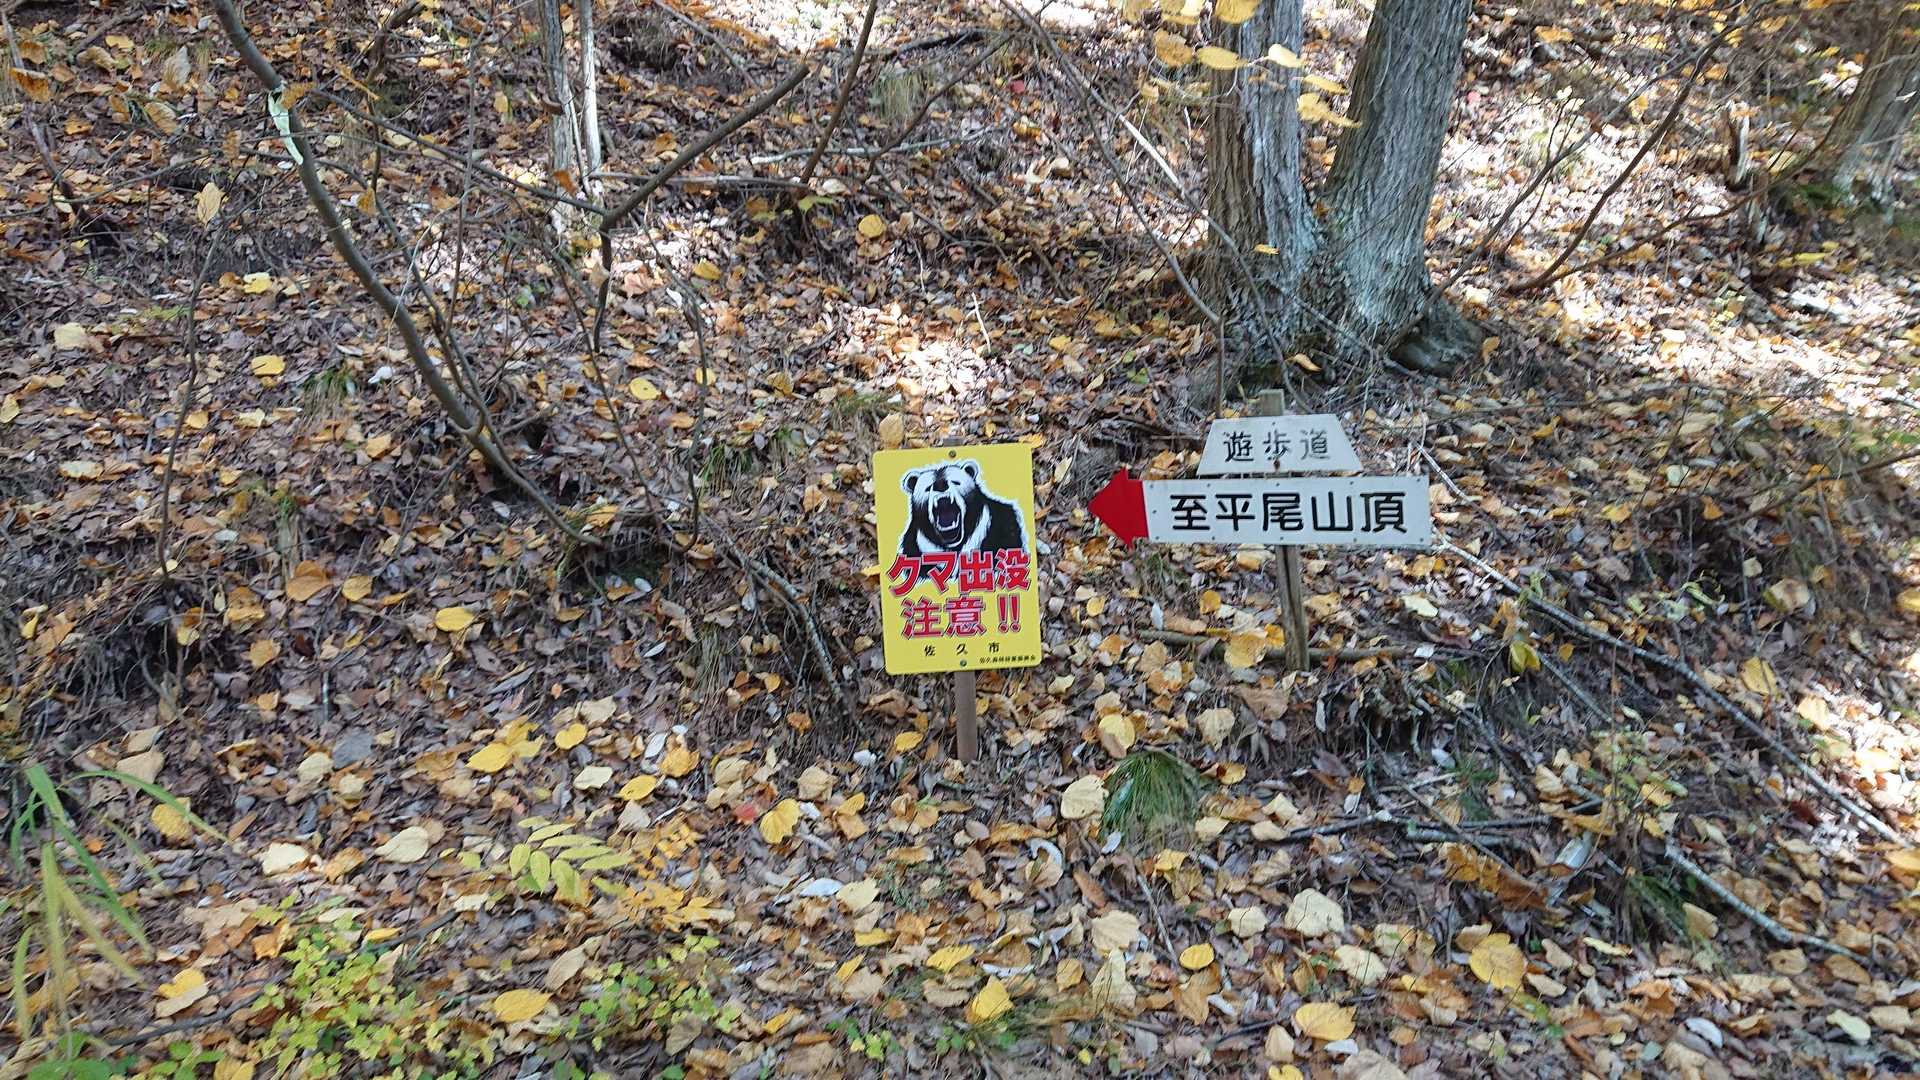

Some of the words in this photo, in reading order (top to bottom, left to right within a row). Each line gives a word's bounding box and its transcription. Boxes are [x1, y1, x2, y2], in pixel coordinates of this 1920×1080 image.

[1222, 429, 1331, 463] 遊歩道
[1170, 491, 1408, 534] 至平尾山頂
[886, 547, 1031, 597] クマ出没
[923, 641, 1000, 657] 佐久市
